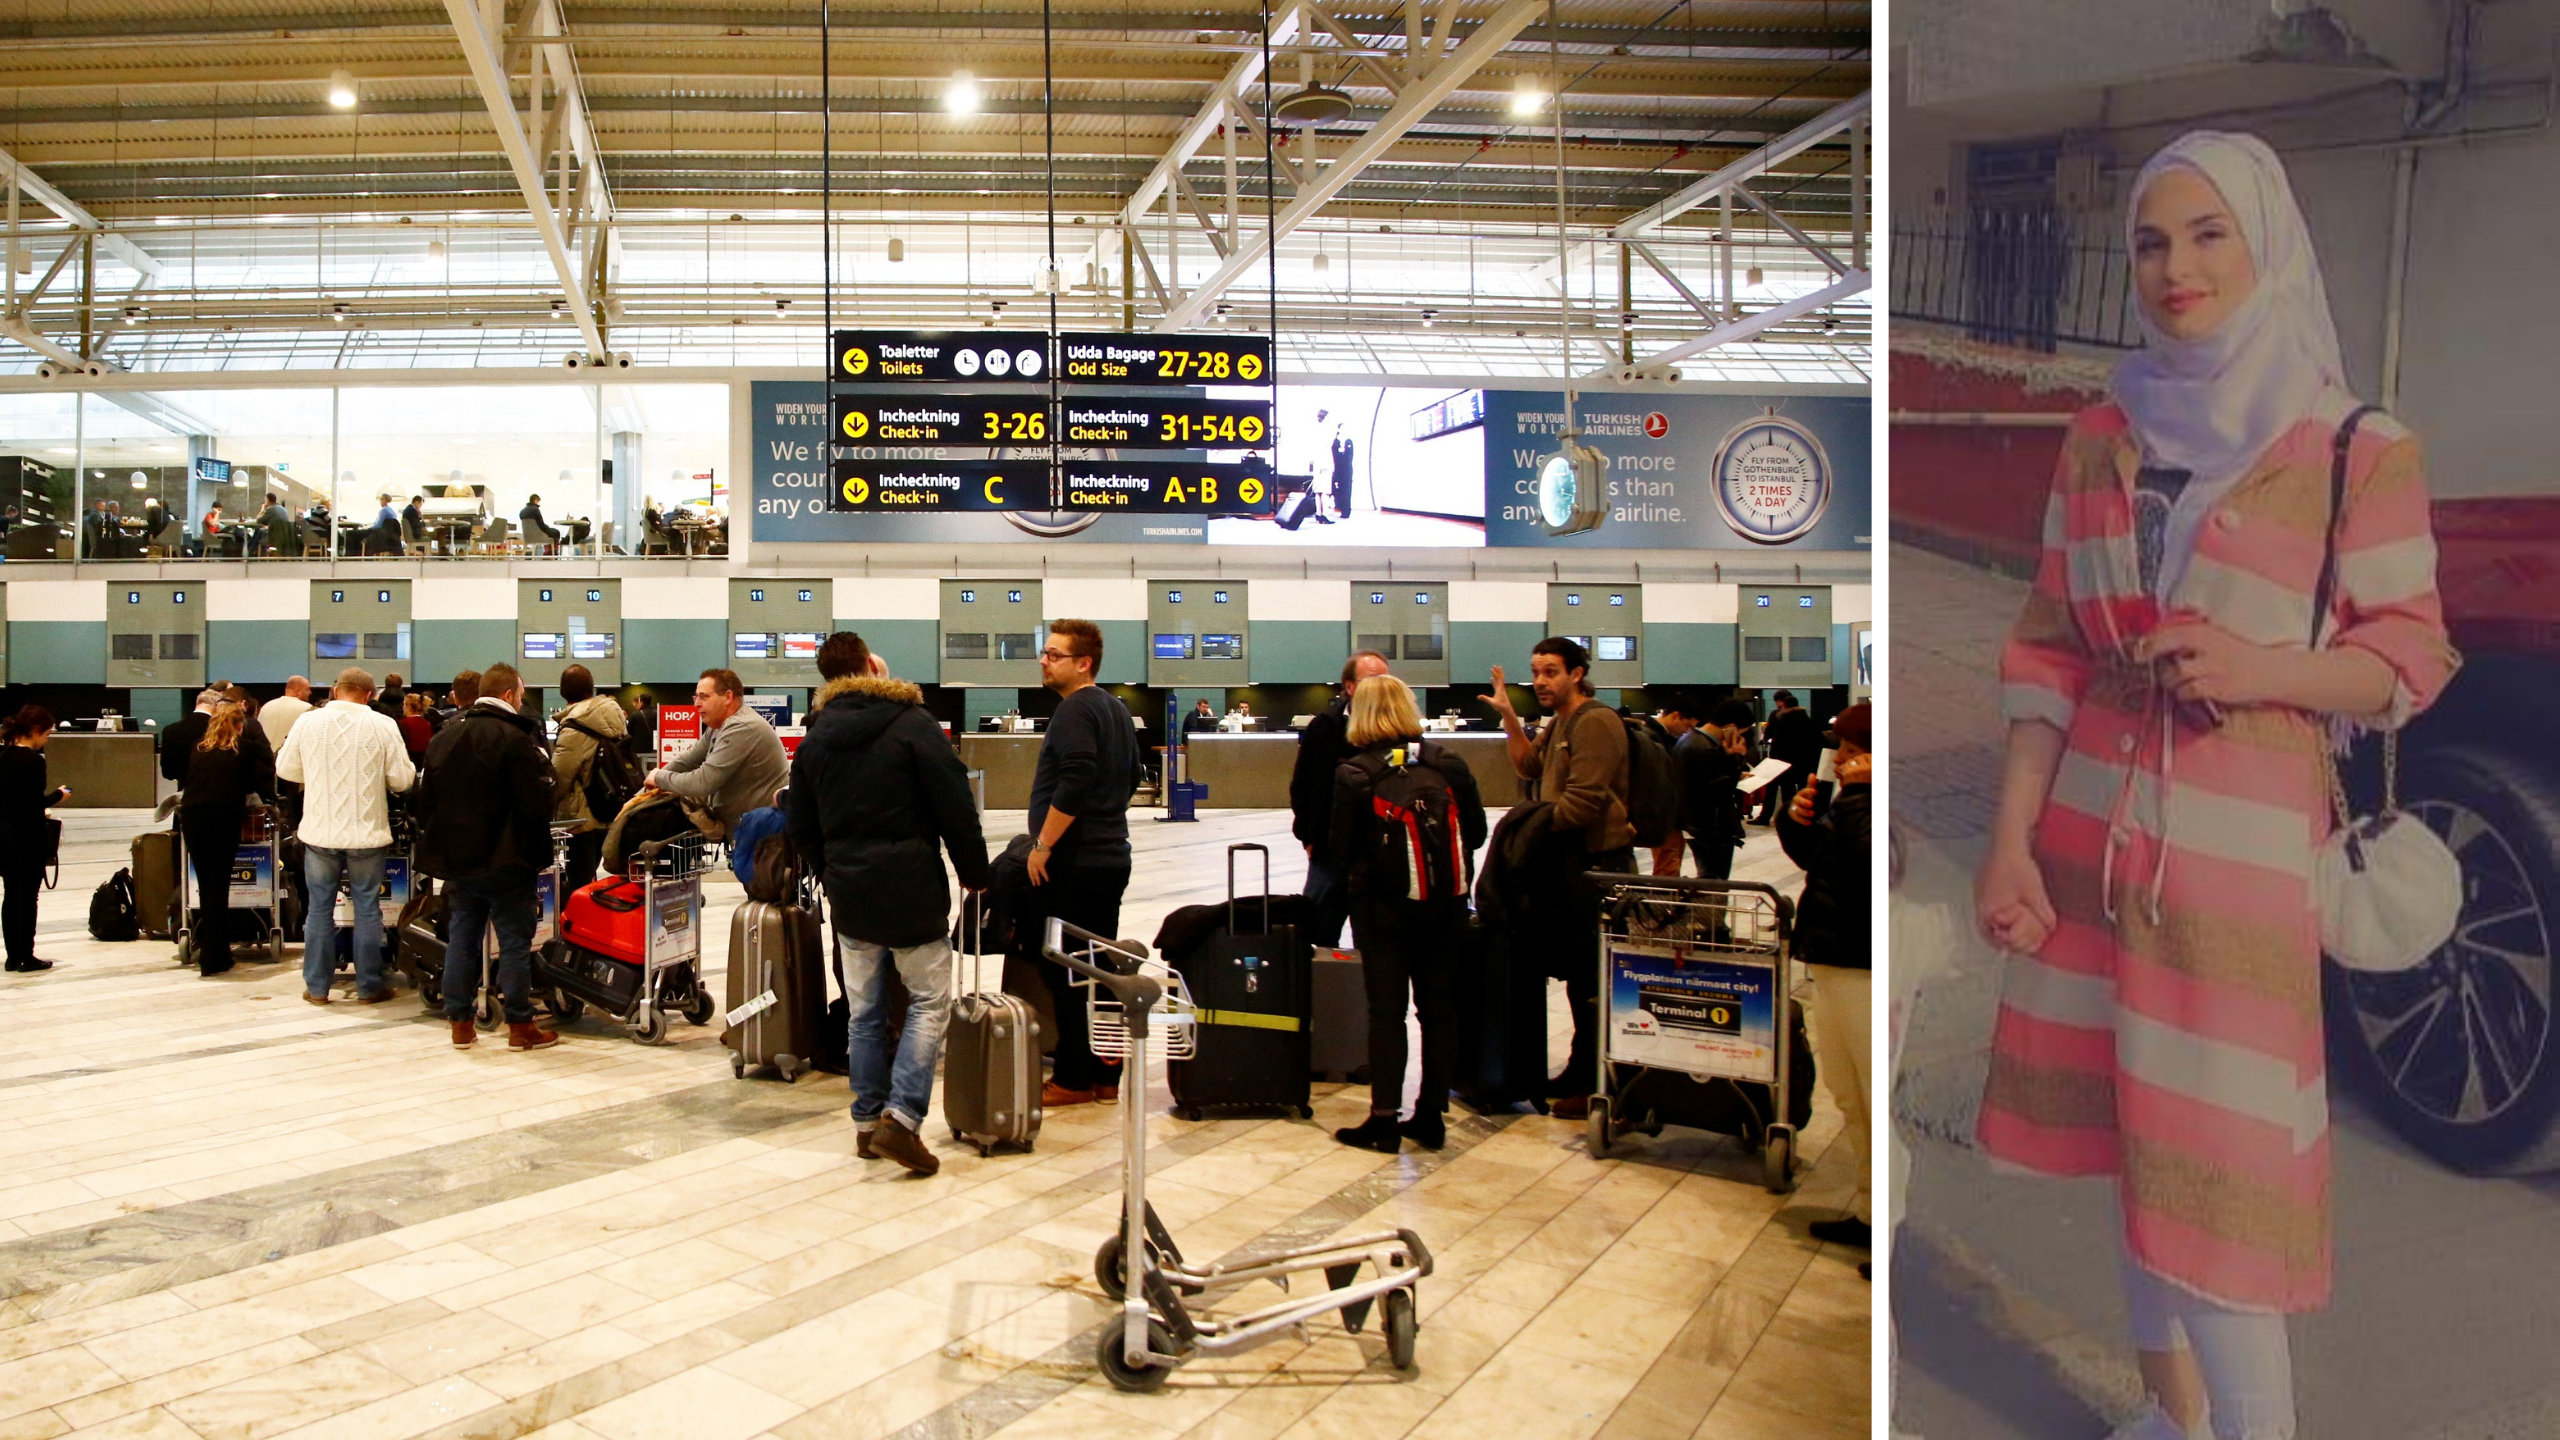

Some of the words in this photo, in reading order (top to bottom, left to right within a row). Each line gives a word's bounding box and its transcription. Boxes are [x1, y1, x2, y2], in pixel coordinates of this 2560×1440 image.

[879, 344, 940, 358] Toaletter
[1067, 345, 1103, 360] Udda
[1106, 347, 1156, 363] Bagage
[879, 362, 923, 375] Toilets
[1068, 362, 1097, 376] Odd
[1101, 363, 1128, 376] Size
[1158, 350, 1231, 378] 27-28
[775, 403, 803, 414] WIDEN
[805, 403, 827, 414] YOUR
[878, 409, 960, 426] Incheckning
[1069, 410, 1149, 427] Incheckning
[1516, 412, 1543, 423] WIDEN
[1544, 413, 1566, 424] YOUR
[1584, 414, 1641, 424] TURKISH
[983, 412, 1045, 439] 3-26
[1160, 414, 1237, 441] 31-54
[1584, 425, 1642, 436] AIRLINES
[879, 425, 939, 439] Check-in
[1069, 426, 1128, 440] Check-in
[770, 441, 809, 461] We
[885, 447, 947, 460] more
[1617, 456, 1676, 470] more
[1751, 457, 1764, 465] FLY
[1766, 457, 1789, 465] FROM
[1743, 466, 1800, 474] GOTHENBURG
[879, 473, 961, 490] Incheckning
[1069, 474, 1150, 491] Incheckning
[1758, 475, 1796, 483] ISTANBUL
[984, 476, 1004, 503] C
[1626, 477, 1674, 496] than
[1749, 485, 1757, 496] 2
[1758, 486, 1792, 496] TIMES
[879, 490, 939, 504] Check-in
[1070, 491, 1128, 505] Check-in
[1754, 497, 1762, 507] A
[1765, 498, 1787, 507] DAY
[758, 498, 801, 519] any
[1614, 503, 1687, 522] airline.
[1142, 527, 1203, 536] TURKISHAIRLINES.COM
[130, 593, 138, 603] 5
[176, 593, 183, 603] 6
[334, 592, 342, 602] 7
[381, 592, 388, 602] 8
[542, 591, 550, 601] 9
[587, 591, 600, 601] 10
[751, 590, 763, 601] 11
[799, 591, 811, 601] 12
[961, 592, 974, 602] 13
[1008, 592, 1021, 602] 14
[1169, 593, 1181, 602] 15
[1215, 593, 1227, 602] 16
[1371, 594, 1383, 603] 17
[1415, 594, 1428, 603] 18
[1567, 596, 1579, 605] 19
[1610, 596, 1622, 605] 20
[1757, 597, 1768, 606] 21
[1799, 597, 1811, 606] 22
[665, 711, 695, 722] HOP!
[1623, 970, 1683, 985] Flygplatsen
[1685, 978, 1730, 990] närmast
[1733, 983, 1759, 994] city!
[1650, 1002, 1706, 1019] Terminal
